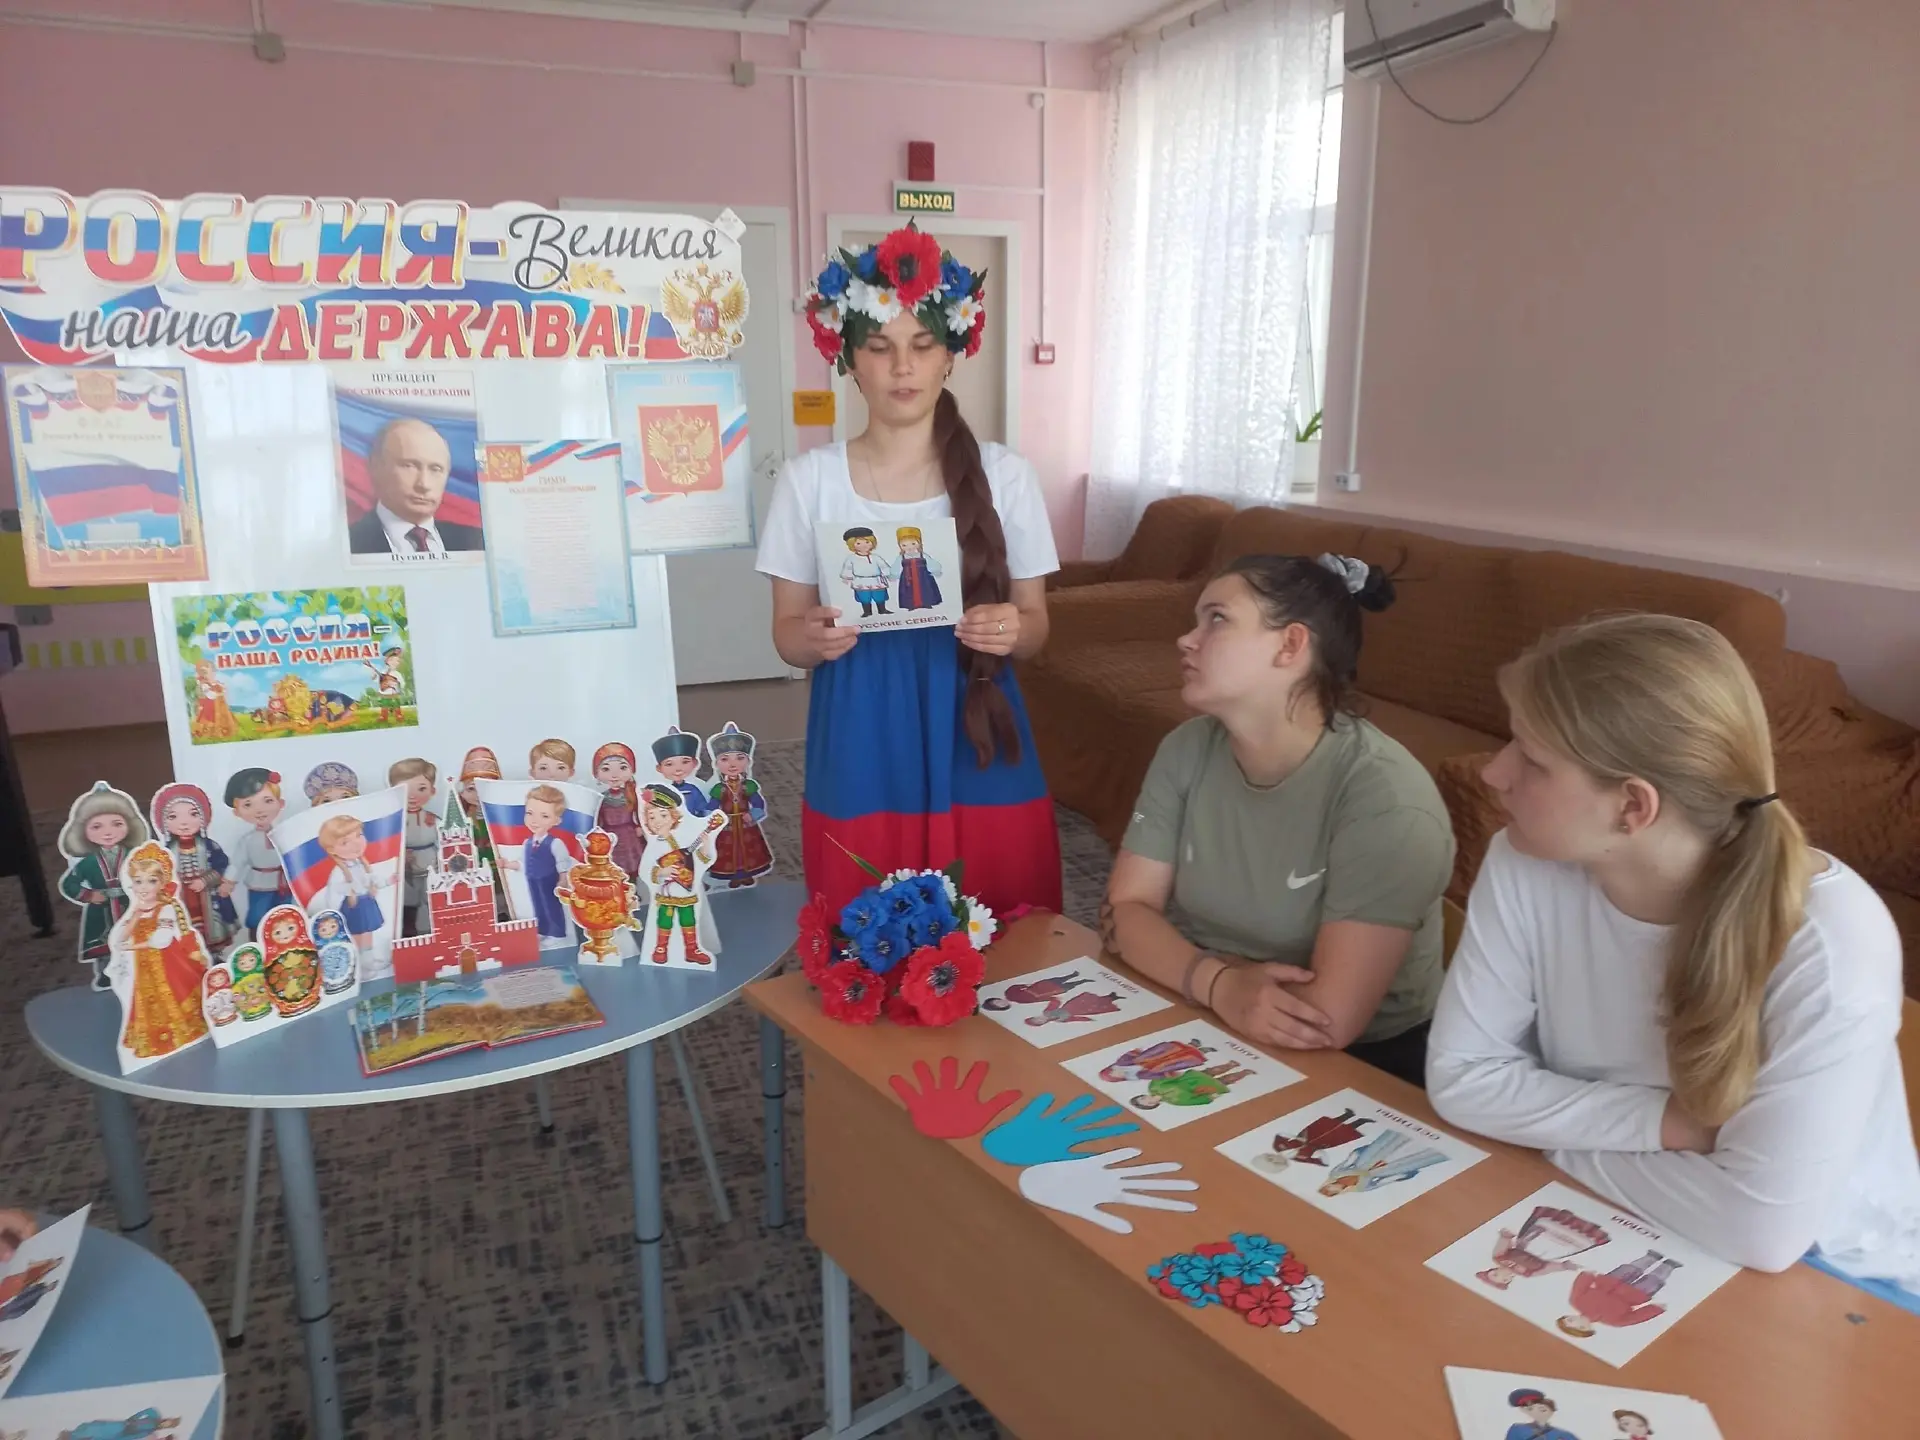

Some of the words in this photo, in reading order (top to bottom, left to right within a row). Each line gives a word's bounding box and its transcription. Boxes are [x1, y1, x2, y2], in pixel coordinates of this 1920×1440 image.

[899, 191, 953, 210] ВЫХОД
[0, 191, 507, 289] РОССИЯ-
[508, 213, 723, 290] Великая
[63, 309, 248, 349] наша
[258, 302, 651, 361] ДЕРЖАВА!
[372, 373, 436, 384] ПРЕИДЕНТ
[205, 613, 392, 649] РОССИЯ-
[858, 620, 902, 629] УССКИЕ
[905, 615, 949, 625] СЕВЕРА
[217, 651, 281, 669] НАША
[290, 642, 381, 665] РОДИНА!
[1375, 1108, 1440, 1140] ОСЕТИНЫ
[1610, 1215, 1661, 1240] КОМИ
